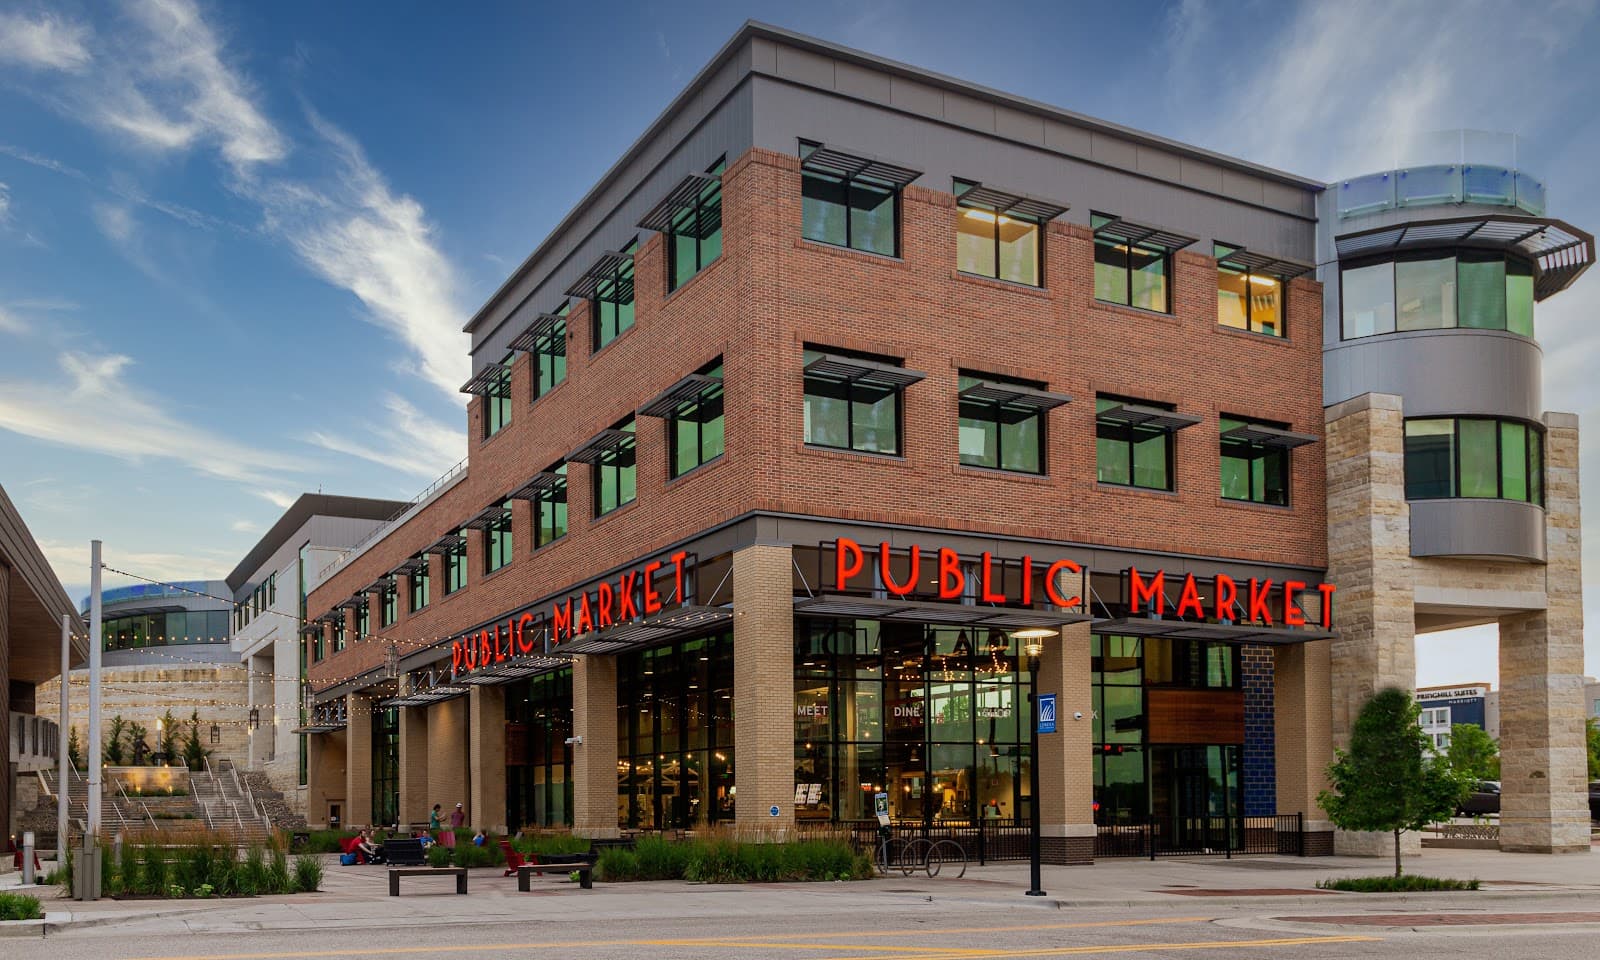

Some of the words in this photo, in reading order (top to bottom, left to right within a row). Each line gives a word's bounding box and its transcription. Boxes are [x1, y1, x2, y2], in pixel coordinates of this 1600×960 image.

[835, 537, 1082, 608] PUBLIC
[1130, 566, 1337, 628] MARKET
[452, 612, 534, 675] PUBLIC
[553, 551, 686, 642] MARKET
[797, 705, 828, 716] MEET
[894, 706, 920, 717] DINE
